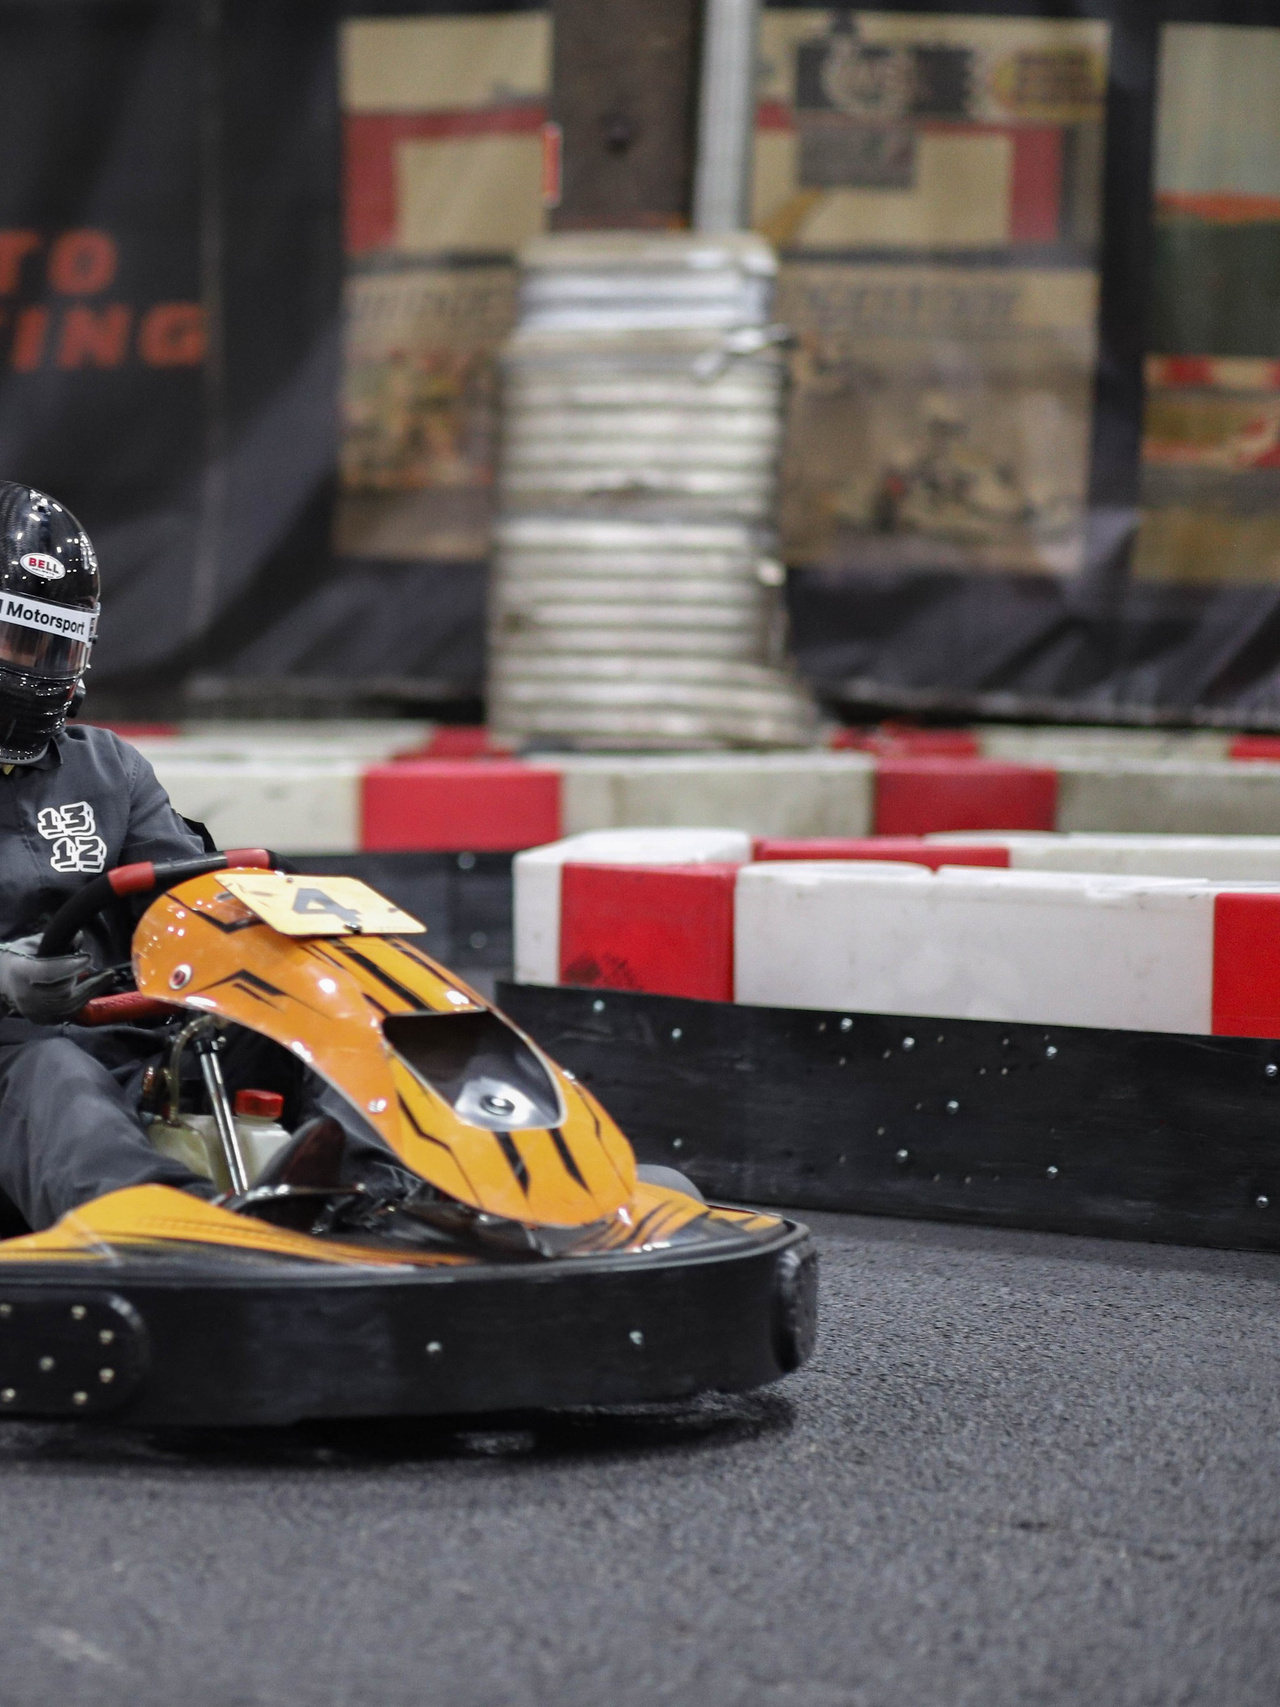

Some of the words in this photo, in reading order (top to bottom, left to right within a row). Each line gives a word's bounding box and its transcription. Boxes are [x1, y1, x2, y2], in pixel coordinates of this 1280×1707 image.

[28, 556, 59, 574] BELL
[6, 601, 85, 635] Motorsport
[37, 801, 96, 839] 13
[50, 836, 107, 873] 12
[292, 887, 362, 923] 4
